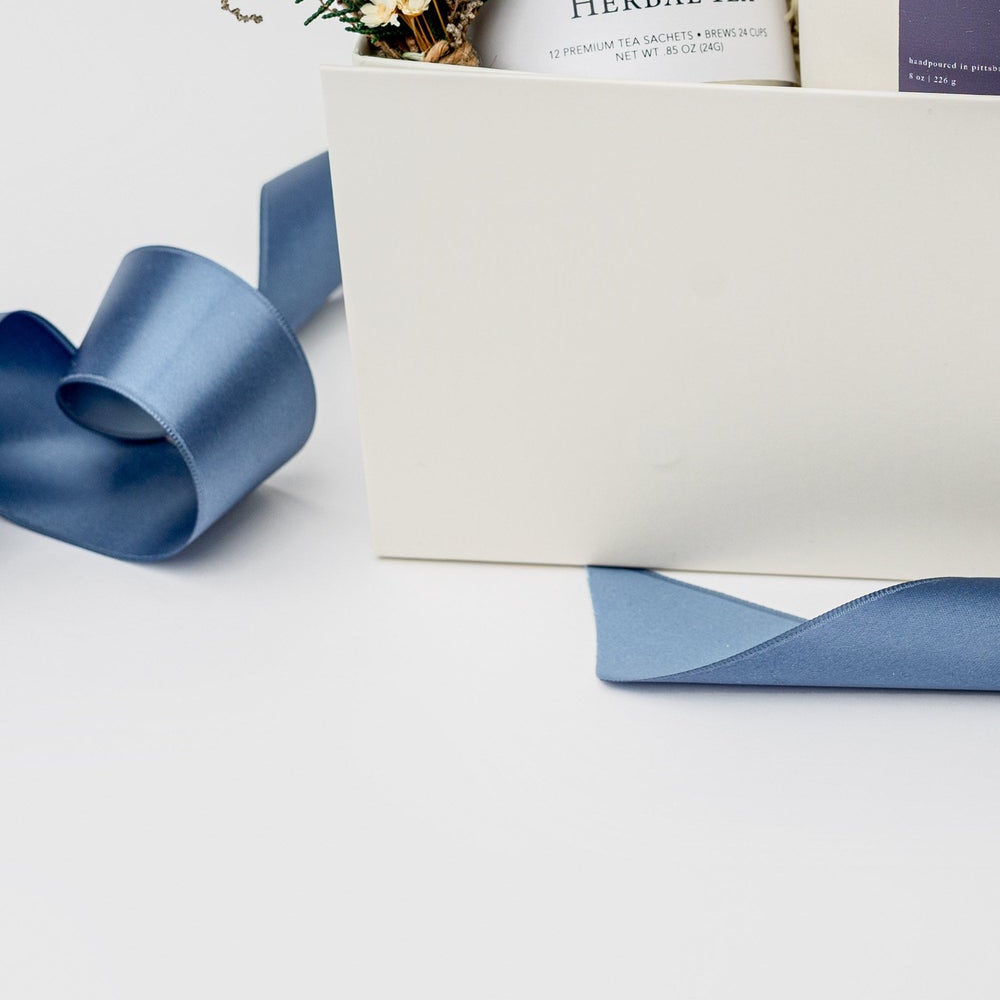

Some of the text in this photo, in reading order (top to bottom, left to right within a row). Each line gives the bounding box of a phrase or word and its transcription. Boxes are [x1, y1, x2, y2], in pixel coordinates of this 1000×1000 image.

[549, 49, 560, 60] 12
[563, 40, 615, 57] PREMIUM
[618, 36, 641, 48] TEA
[643, 30, 694, 45] SACHETS
[704, 28, 737, 39] BREWS
[738, 27, 748, 38] 24
[749, 27, 768, 38] CUPS
[615, 41, 724, 62] NET WT .85 OZ (24G)
[908, 57, 957, 69] handpoured
[960, 63, 968, 71] in
[933, 76, 949, 84] 226
[951, 79, 957, 87] g
